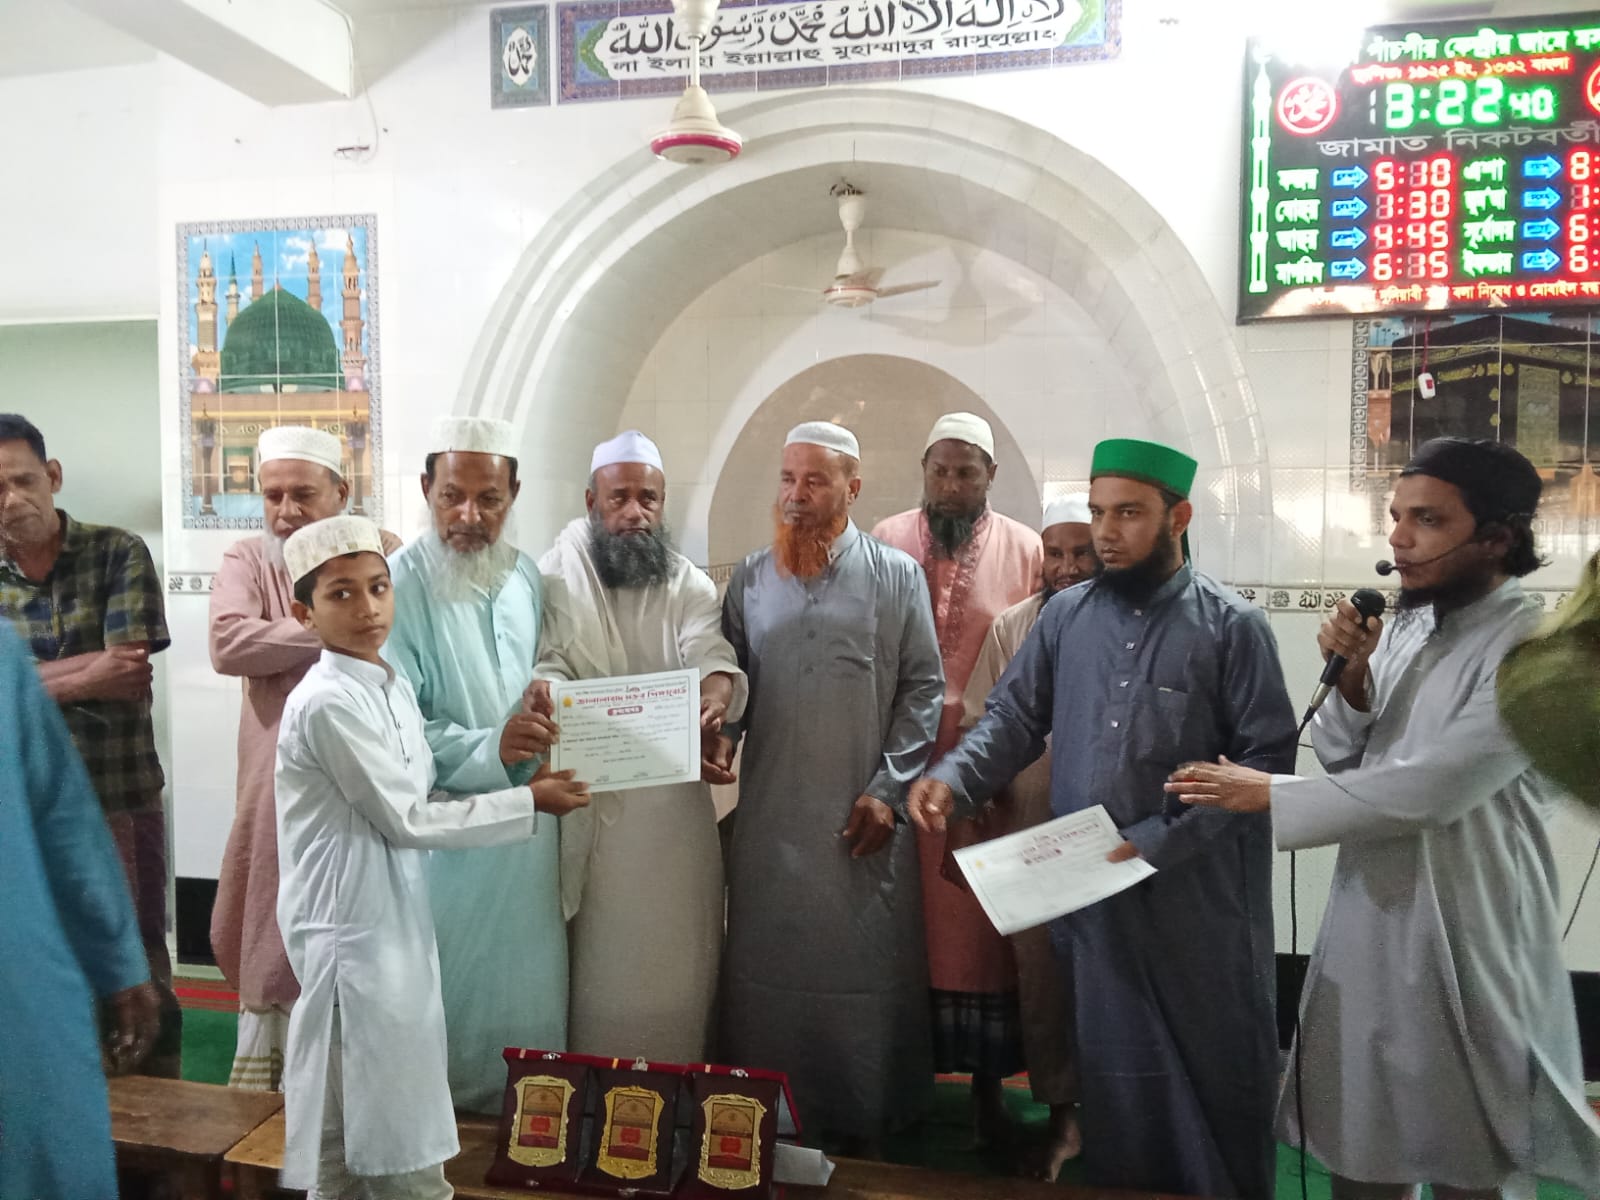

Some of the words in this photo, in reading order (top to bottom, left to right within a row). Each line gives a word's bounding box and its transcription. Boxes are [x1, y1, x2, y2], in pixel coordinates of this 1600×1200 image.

[613, 59, 638, 72] লা
[1317, 136, 1432, 157] জামাত
[1375, 158, 1451, 190] 5:10
[1375, 220, 1448, 249] 4:45
[1373, 251, 1448, 280] 6:15
